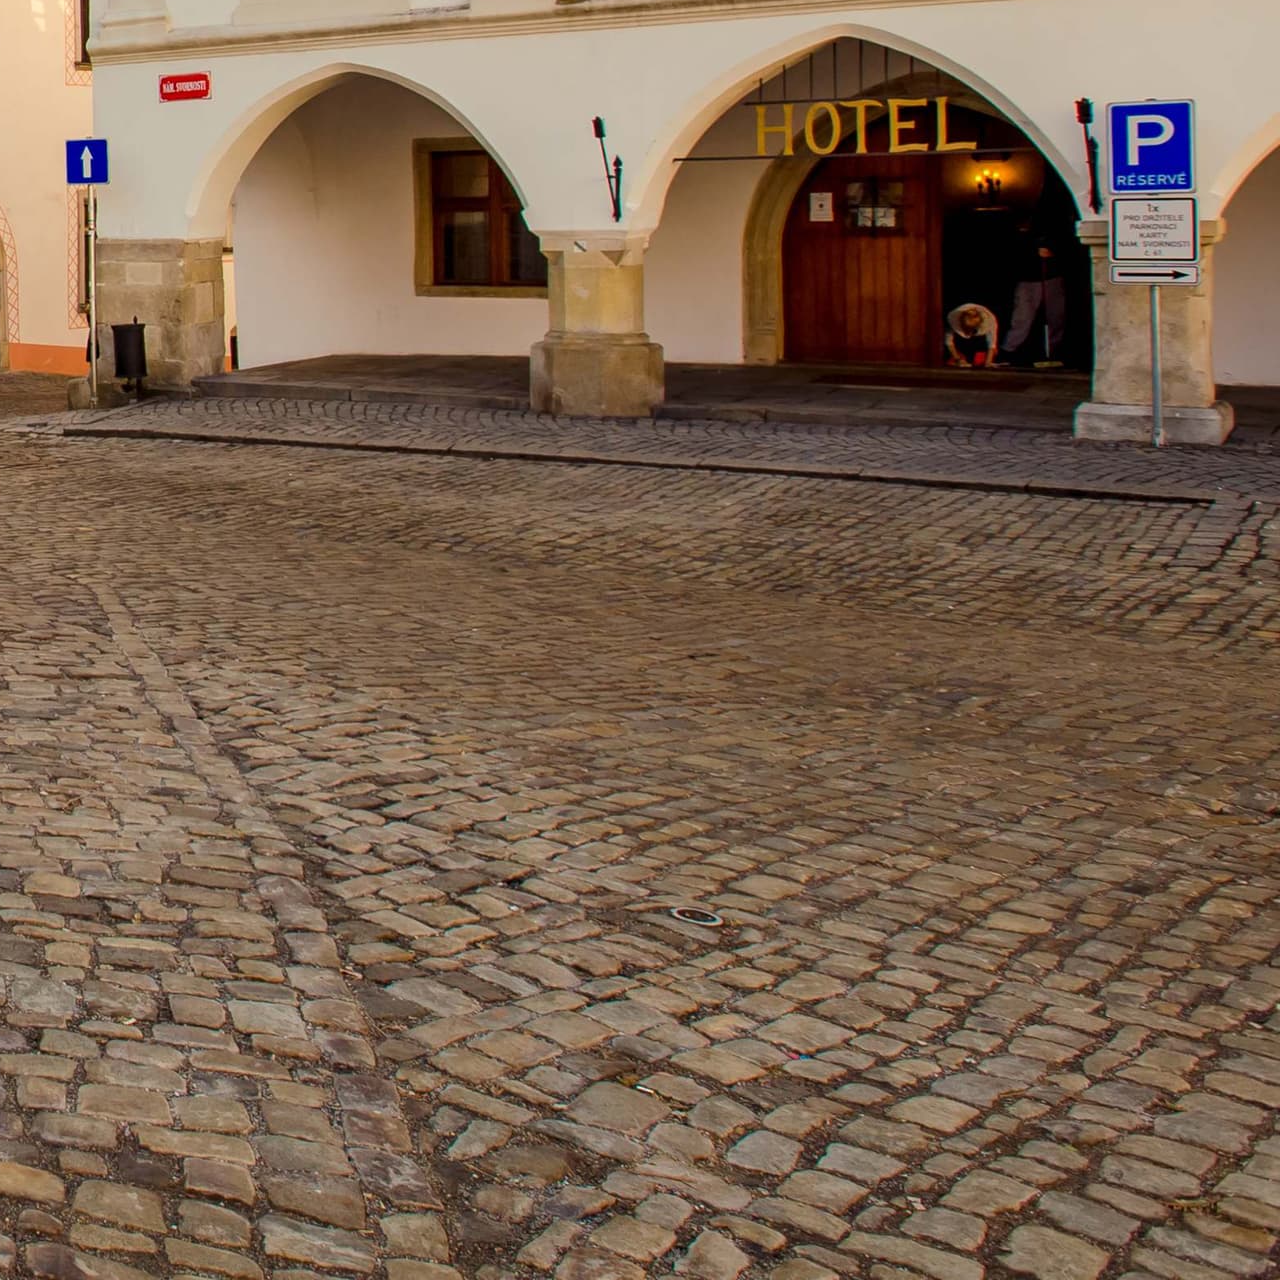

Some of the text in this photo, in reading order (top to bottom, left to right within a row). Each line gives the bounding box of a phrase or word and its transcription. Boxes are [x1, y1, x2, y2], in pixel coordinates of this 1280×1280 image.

[755, 96, 977, 156] HOTEL
[1127, 114, 1175, 166] P
[1116, 172, 1187, 186] RÉSERVÉ
